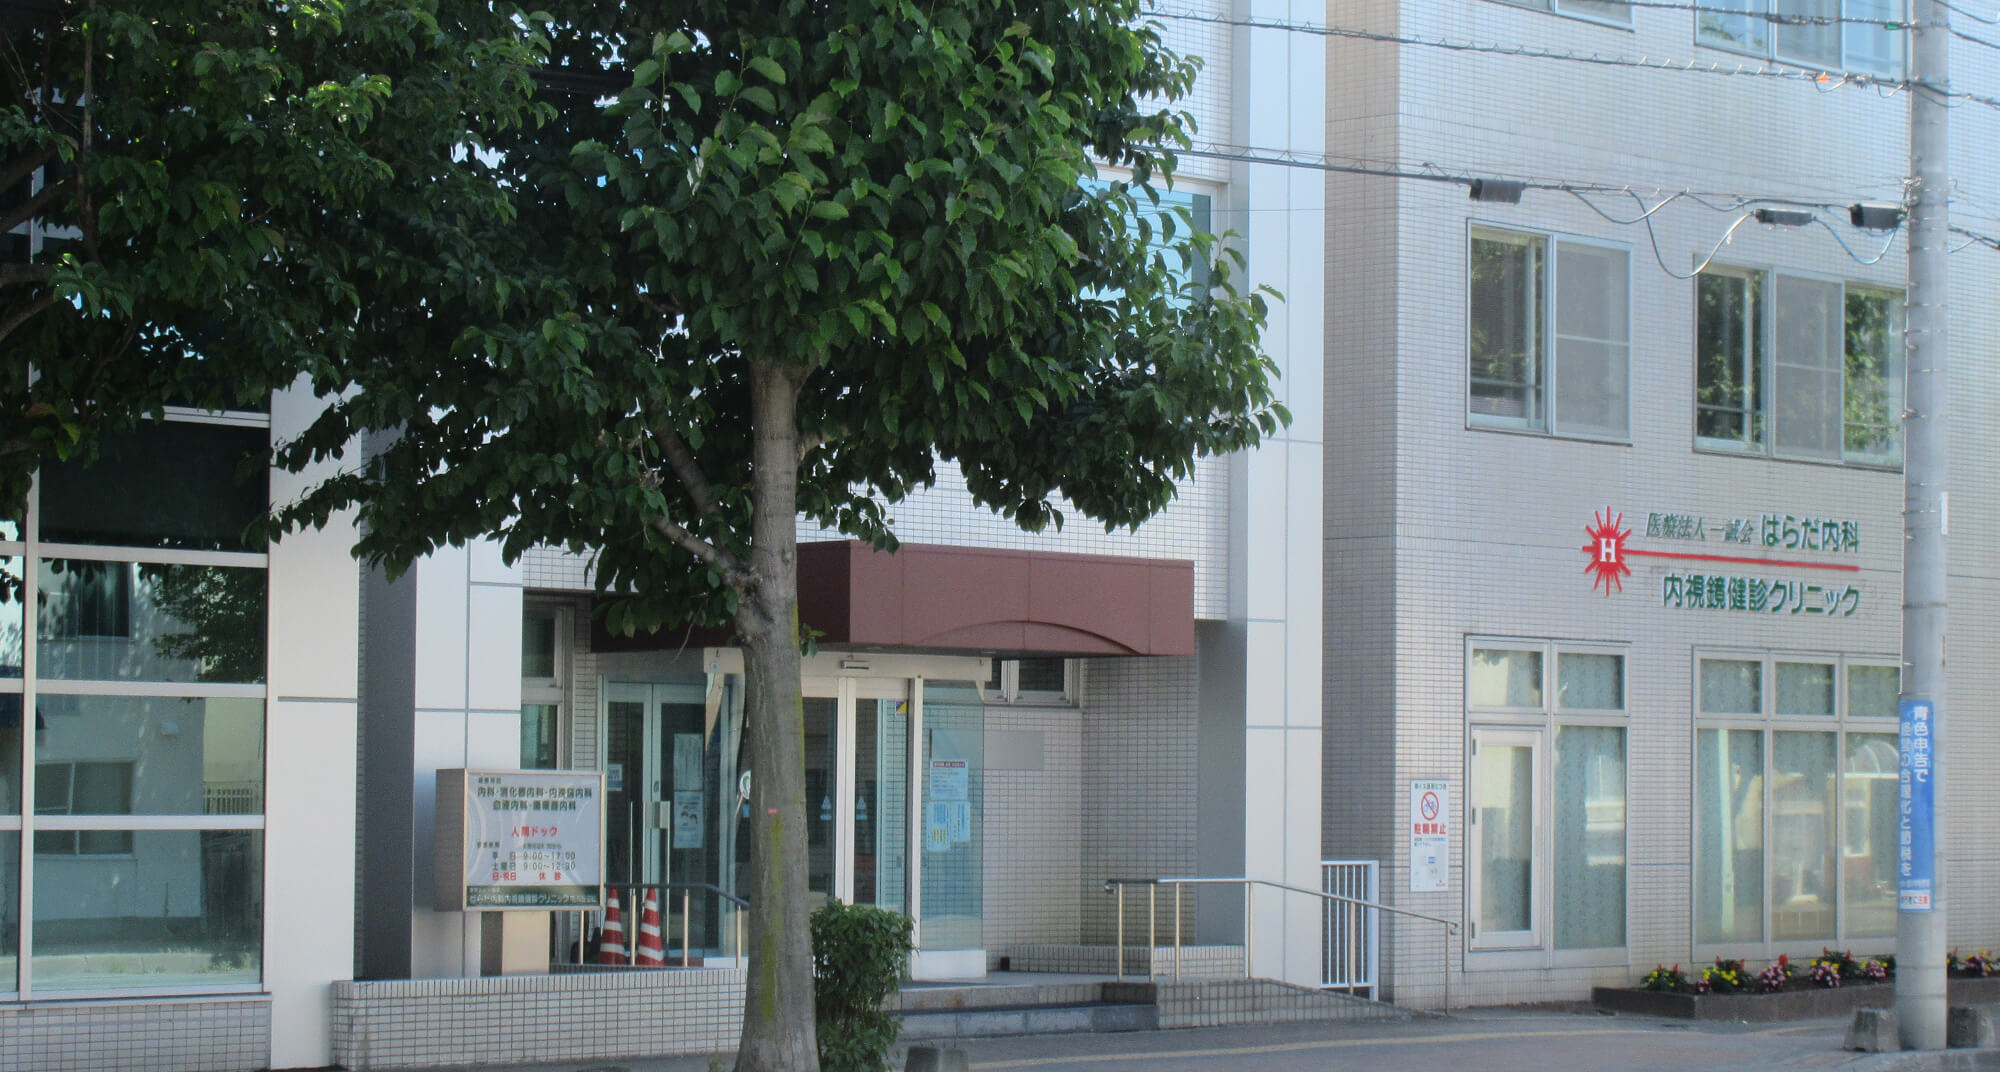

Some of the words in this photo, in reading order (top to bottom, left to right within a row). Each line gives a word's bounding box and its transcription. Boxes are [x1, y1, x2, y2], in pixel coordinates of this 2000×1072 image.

[1600, 538, 1616, 563] H
[1761, 514, 1860, 552] はらだ内科
[1663, 574, 1860, 616] 内視鏡健診クリニック
[1913, 706, 1929, 783] 青色申告で
[511, 825, 559, 837] 人間ドック
